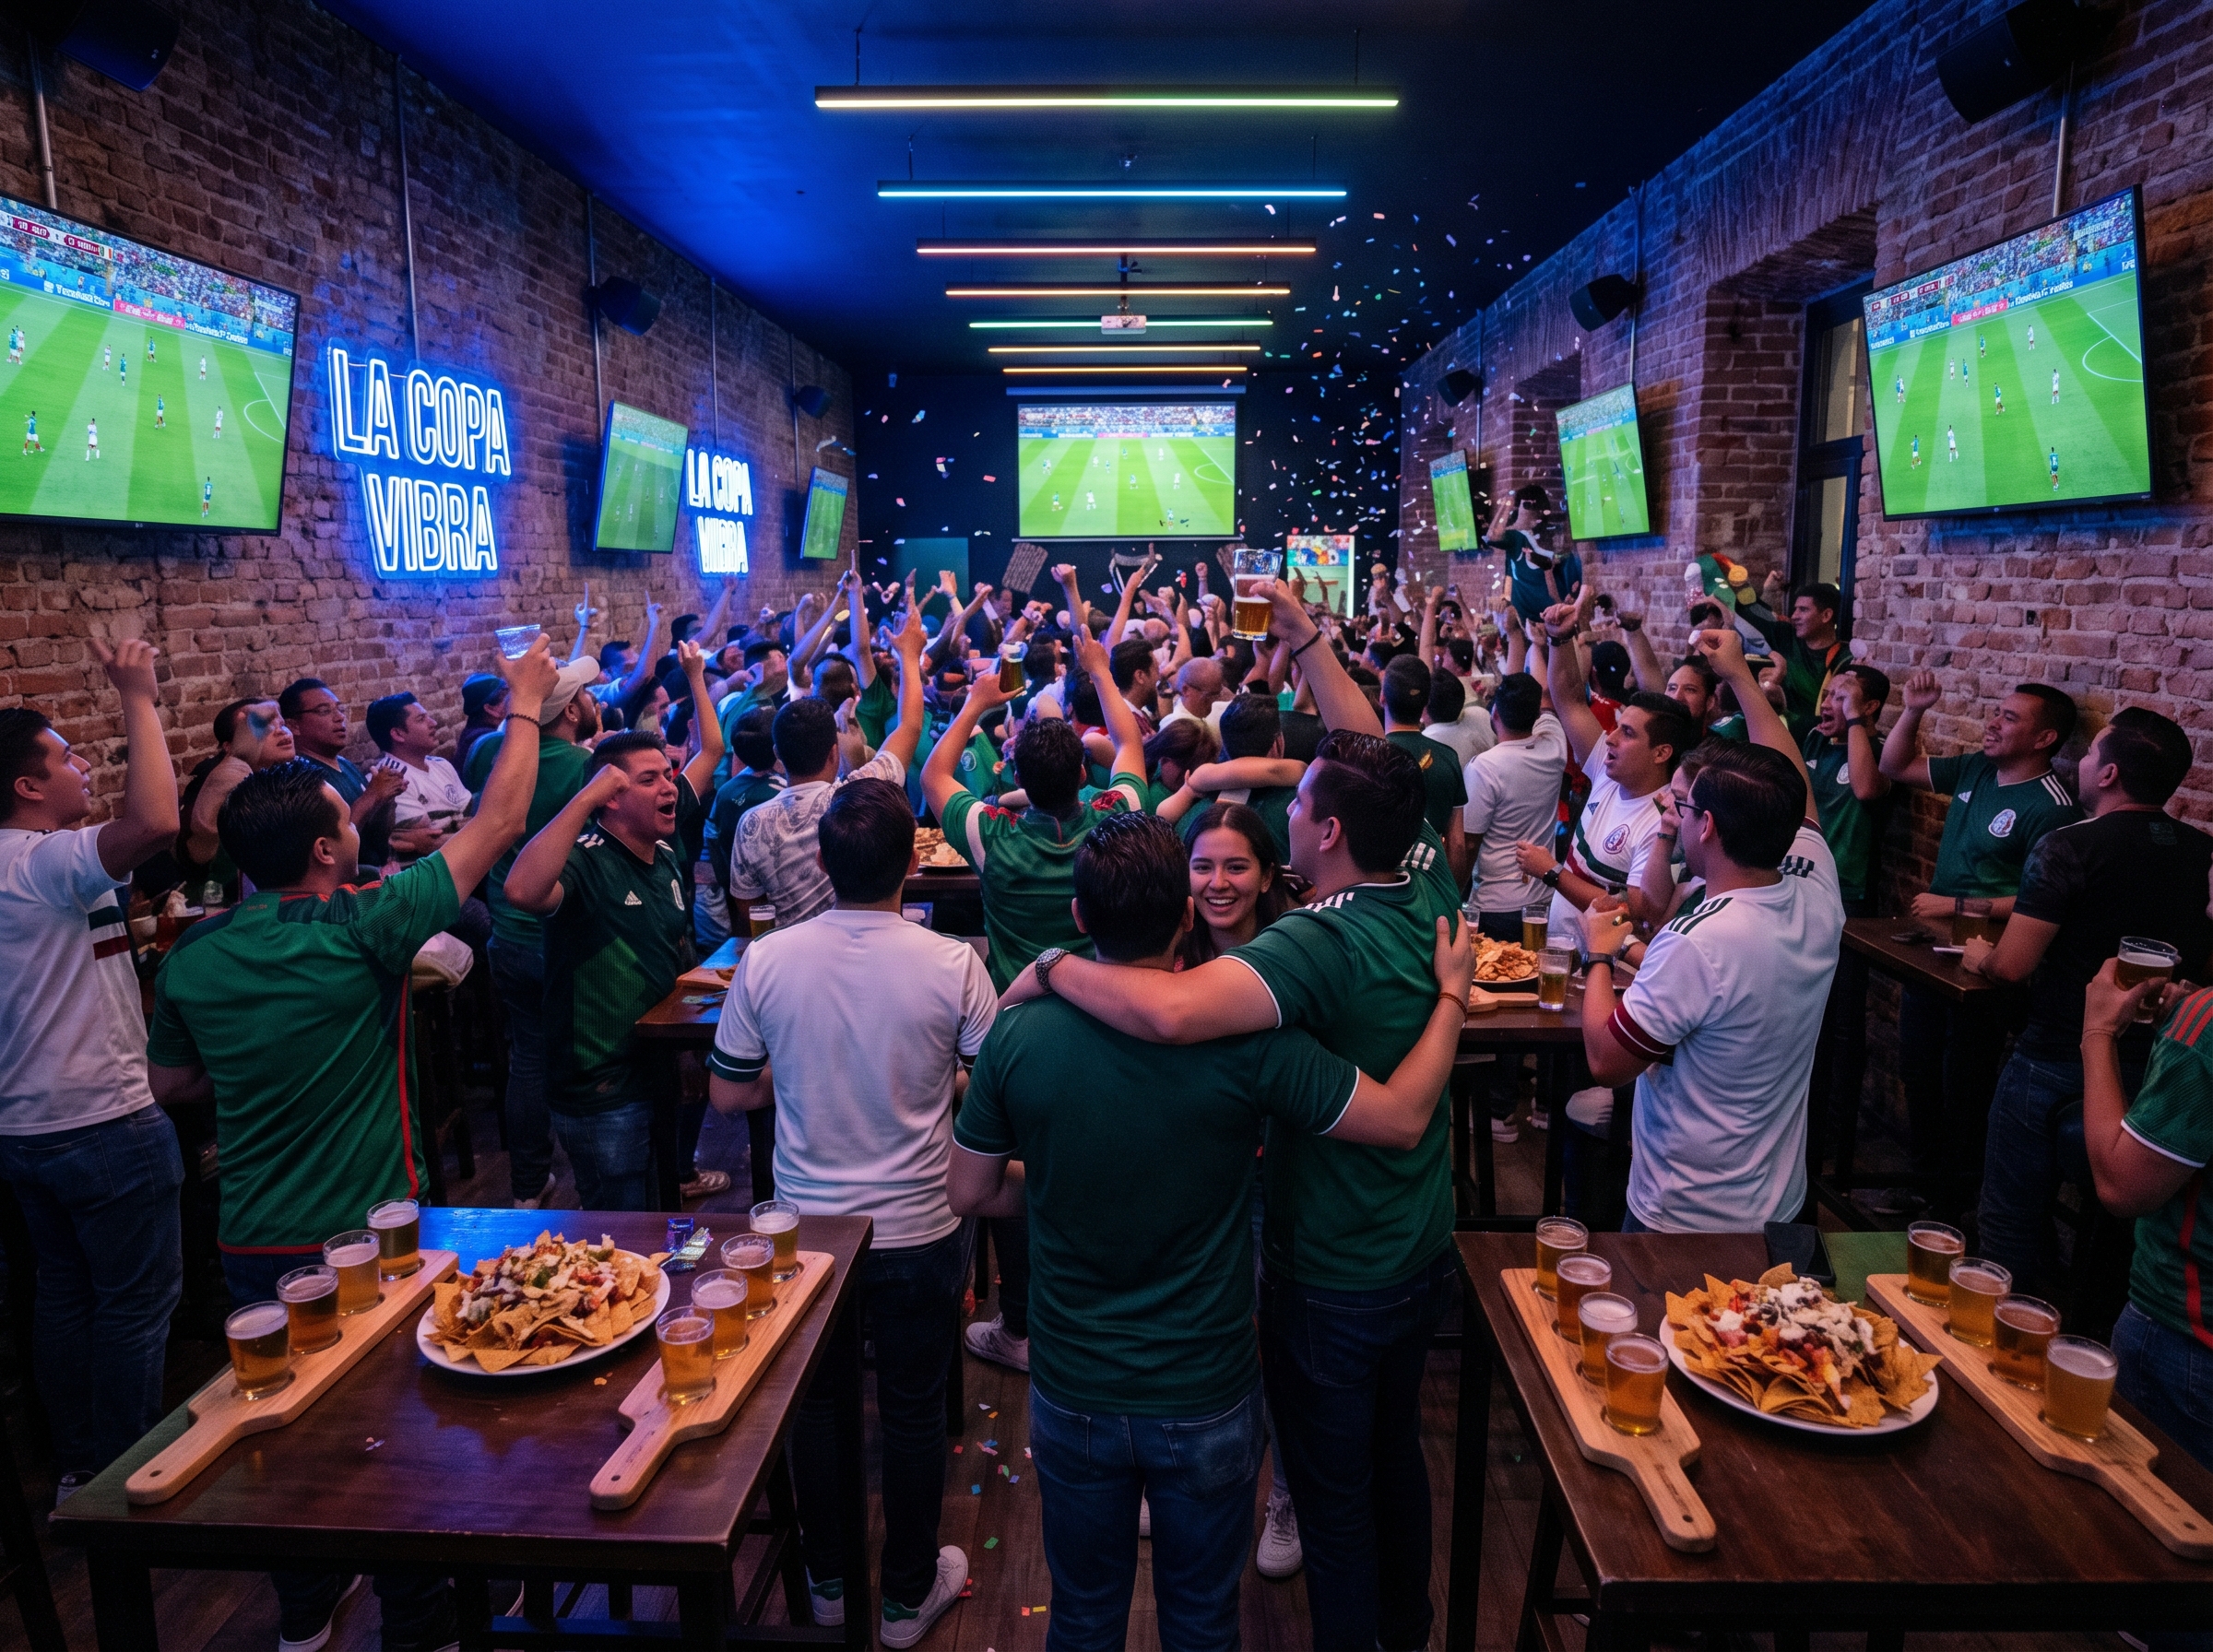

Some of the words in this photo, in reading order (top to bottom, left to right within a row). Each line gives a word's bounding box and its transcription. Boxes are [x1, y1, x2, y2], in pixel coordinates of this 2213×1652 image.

[330, 348, 399, 459] LA
[406, 369, 512, 477] COPA
[366, 473, 499, 572] VIBRA
[686, 448, 712, 508] LA
[713, 454, 753, 515] COPA
